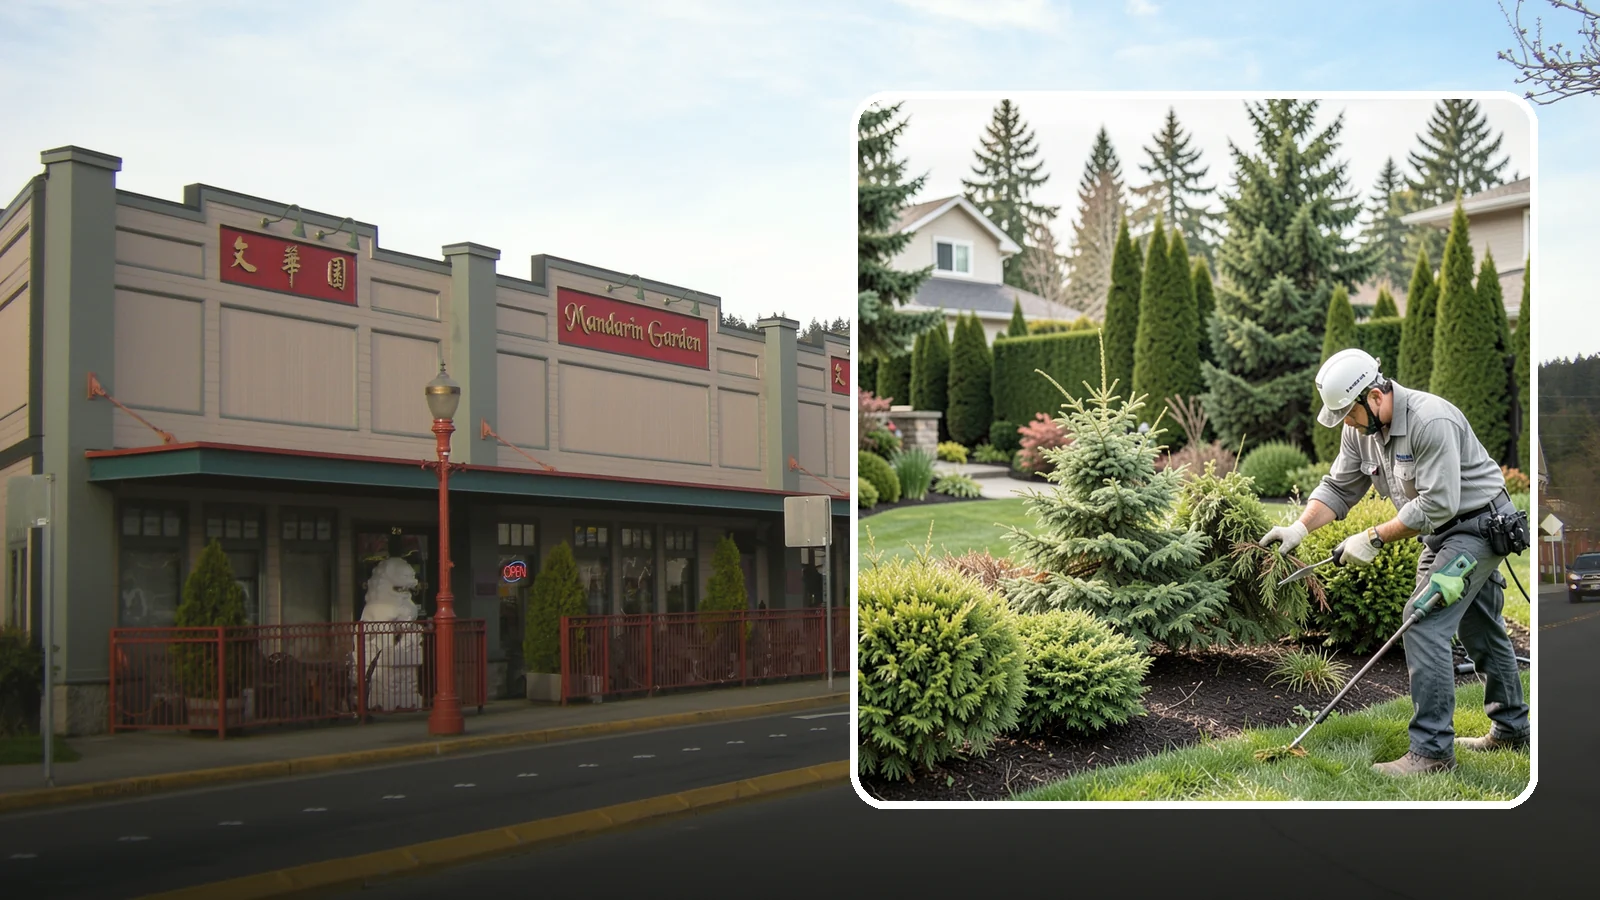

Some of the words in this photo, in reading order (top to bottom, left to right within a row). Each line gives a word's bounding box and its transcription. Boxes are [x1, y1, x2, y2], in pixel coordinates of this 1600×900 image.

[230, 235, 347, 291] 文華園
[564, 302, 644, 341] Mandarin
[648, 320, 702, 352] Garden
[503, 565, 527, 578] OPEN
